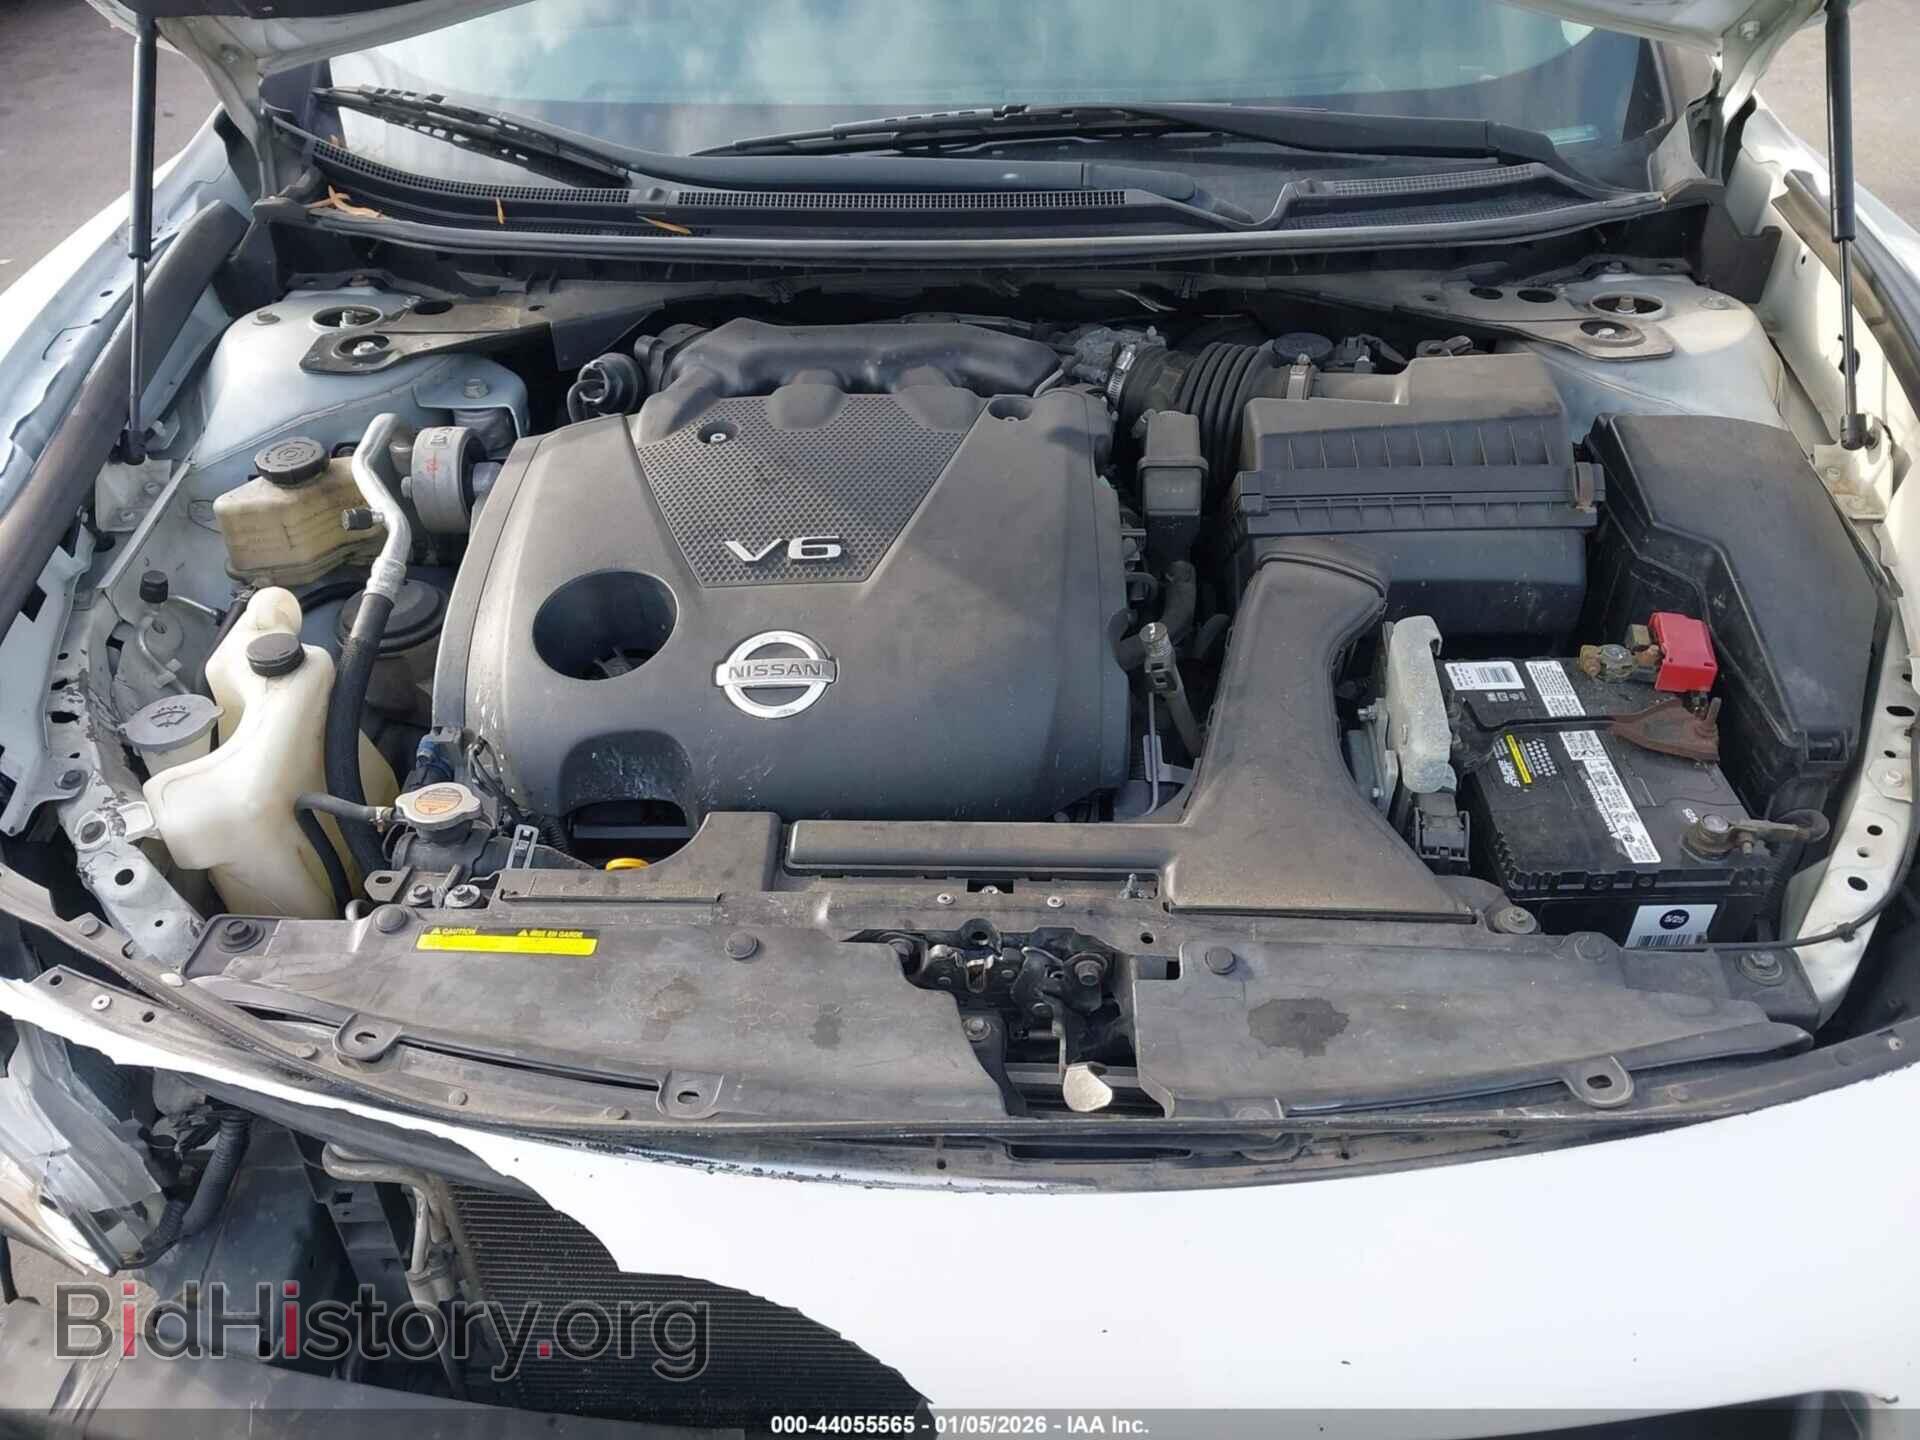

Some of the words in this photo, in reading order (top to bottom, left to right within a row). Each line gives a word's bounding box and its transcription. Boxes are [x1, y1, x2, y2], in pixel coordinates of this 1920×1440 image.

[724, 535, 842, 562] V6
[727, 662, 822, 679] NISSAN
[442, 927, 478, 936] CAUTION
